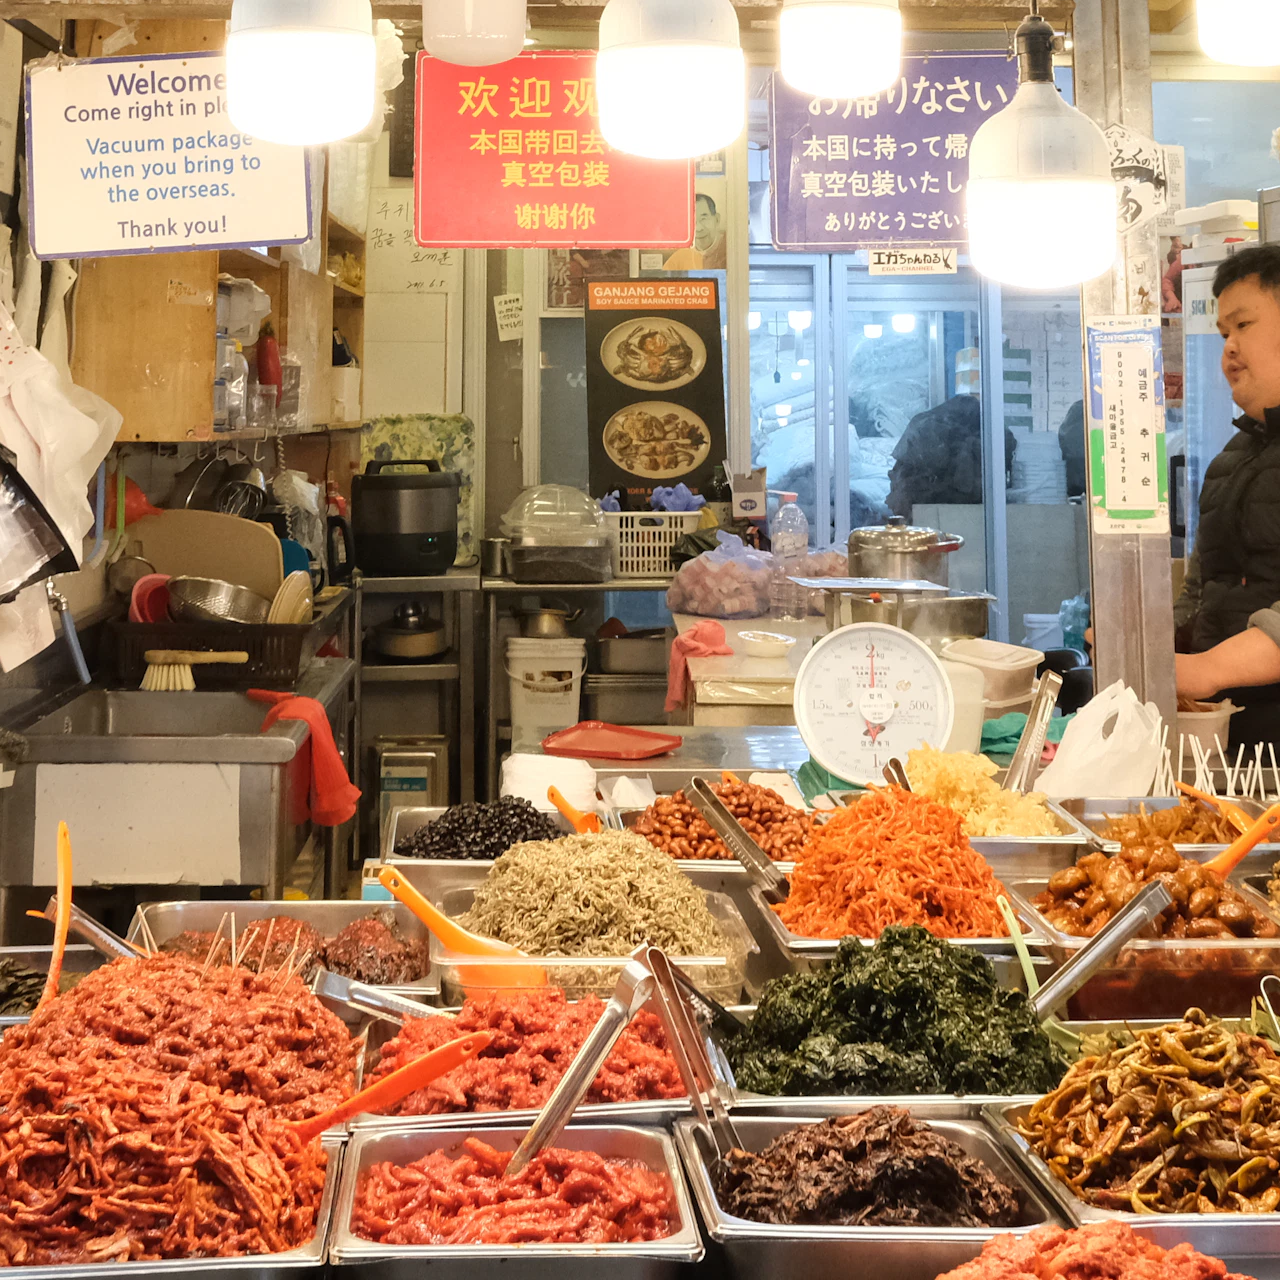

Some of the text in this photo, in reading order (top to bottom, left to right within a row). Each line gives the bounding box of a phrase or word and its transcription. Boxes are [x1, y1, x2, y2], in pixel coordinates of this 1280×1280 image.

[107, 71, 227, 96] Welcome
[64, 104, 121, 123] Come
[127, 100, 174, 122] right
[180, 99, 197, 116] in
[457, 76, 600, 119] 欢迎观
[86, 129, 254, 156] Vacuum package
[469, 129, 610, 156] 本国带回去
[802, 133, 969, 162] 本国に持って帰
[79, 154, 262, 181] when you bring to
[501, 160, 611, 188] 真空包装
[107, 181, 236, 204] the overseas.
[800, 170, 964, 199] 真空包装いたし
[376, 201, 410, 222] 추귀
[514, 202, 597, 230] 谢谢你
[117, 215, 228, 239] Thank you!
[872, 250, 941, 265] エガちゃんねる
[593, 286, 710, 297] GANJANG GEJANG
[1137, 367, 1149, 403] 예금주
